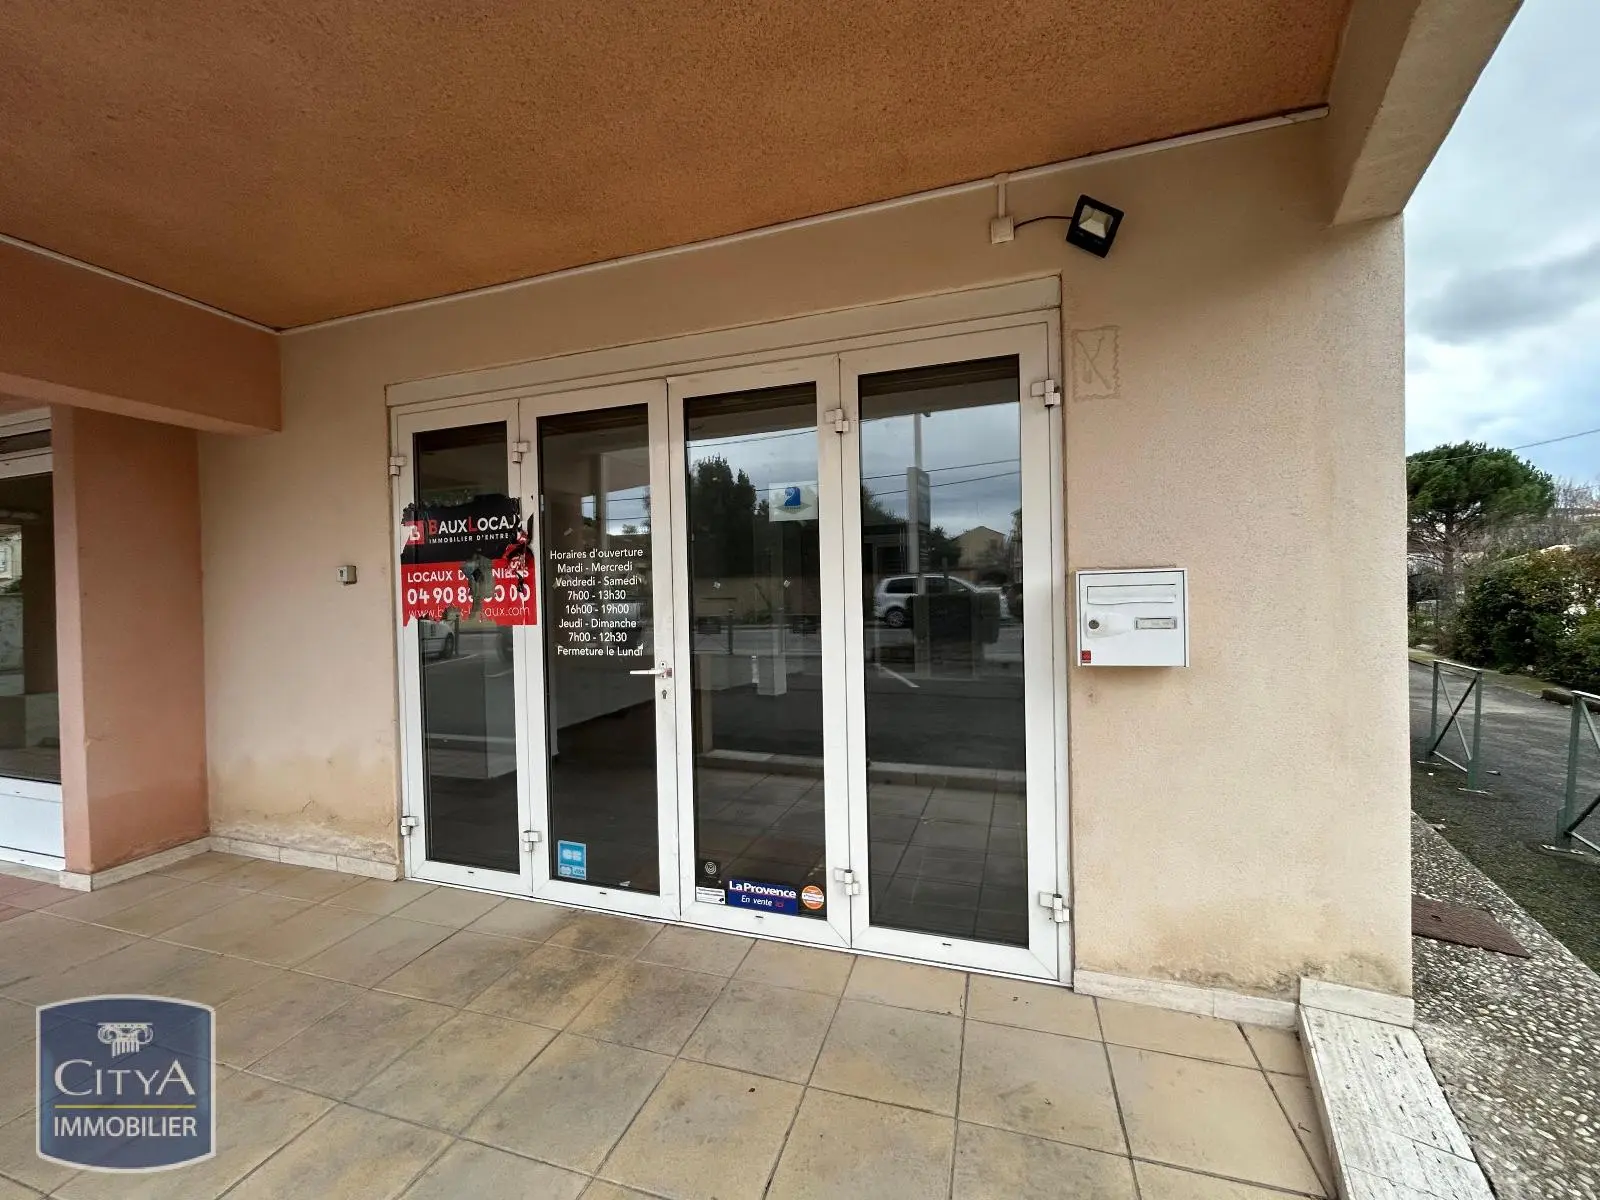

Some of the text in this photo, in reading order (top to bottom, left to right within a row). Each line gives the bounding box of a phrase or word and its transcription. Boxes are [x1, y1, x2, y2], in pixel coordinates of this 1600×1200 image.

[429, 536, 473, 544] IMMOBILIER
[550, 548, 644, 560] Horaires d'ouverture
[557, 563, 583, 573] Mardi
[591, 561, 633, 572] Mercredi
[407, 570, 453, 583] LOCAUX
[555, 576, 596, 587] Vendredi
[603, 575, 638, 586] Samedi
[407, 588, 430, 605] 04
[432, 586, 454, 604] 90
[483, 584, 506, 603] 0
[567, 591, 590, 600] 7h00
[598, 590, 627, 600] 13h30
[565, 605, 593, 614] 16h00
[601, 604, 630, 614] 19h00
[558, 618, 583, 628] Jeudi
[591, 617, 637, 628] Dimanche
[568, 632, 591, 642] 7h00
[599, 632, 628, 642] 12h30
[557, 643, 644, 656] Fermeture le Lundi
[741, 894, 751, 903] En
[753, 897, 773, 907] vente
